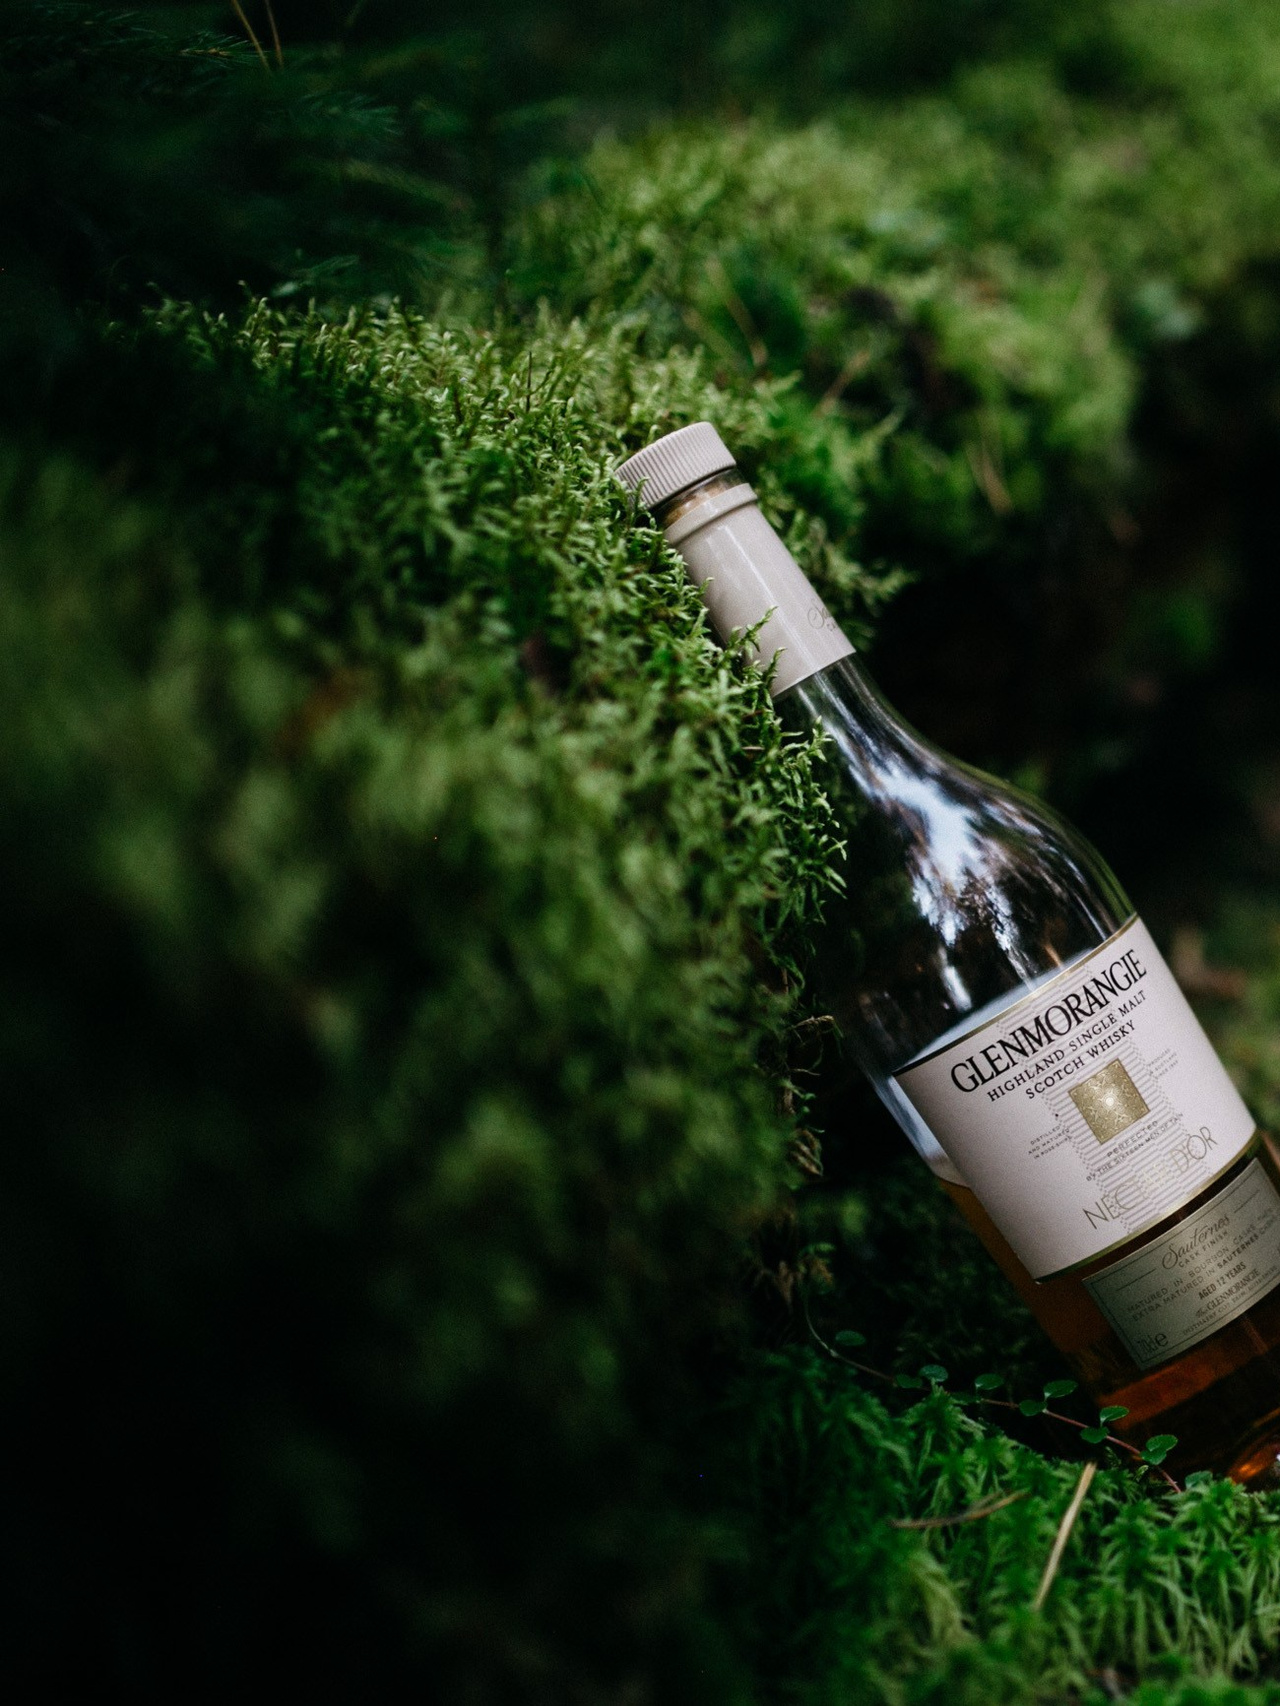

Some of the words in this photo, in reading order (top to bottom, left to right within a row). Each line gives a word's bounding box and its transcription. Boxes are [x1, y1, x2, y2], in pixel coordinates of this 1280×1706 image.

[951, 947, 1148, 1092] GLENMORANGIE
[986, 1048, 1066, 1102] HIGHLAND
[1067, 1012, 1117, 1052] SINGLE
[1117, 989, 1147, 1017] MALT
[1024, 1055, 1085, 1100] SCOTCH
[1085, 1019, 1136, 1060] WHISKY
[1159, 1213, 1231, 1269] Sauternes
[1197, 1282, 1216, 1299] AGED
[1225, 1260, 1247, 1280] YEARS
